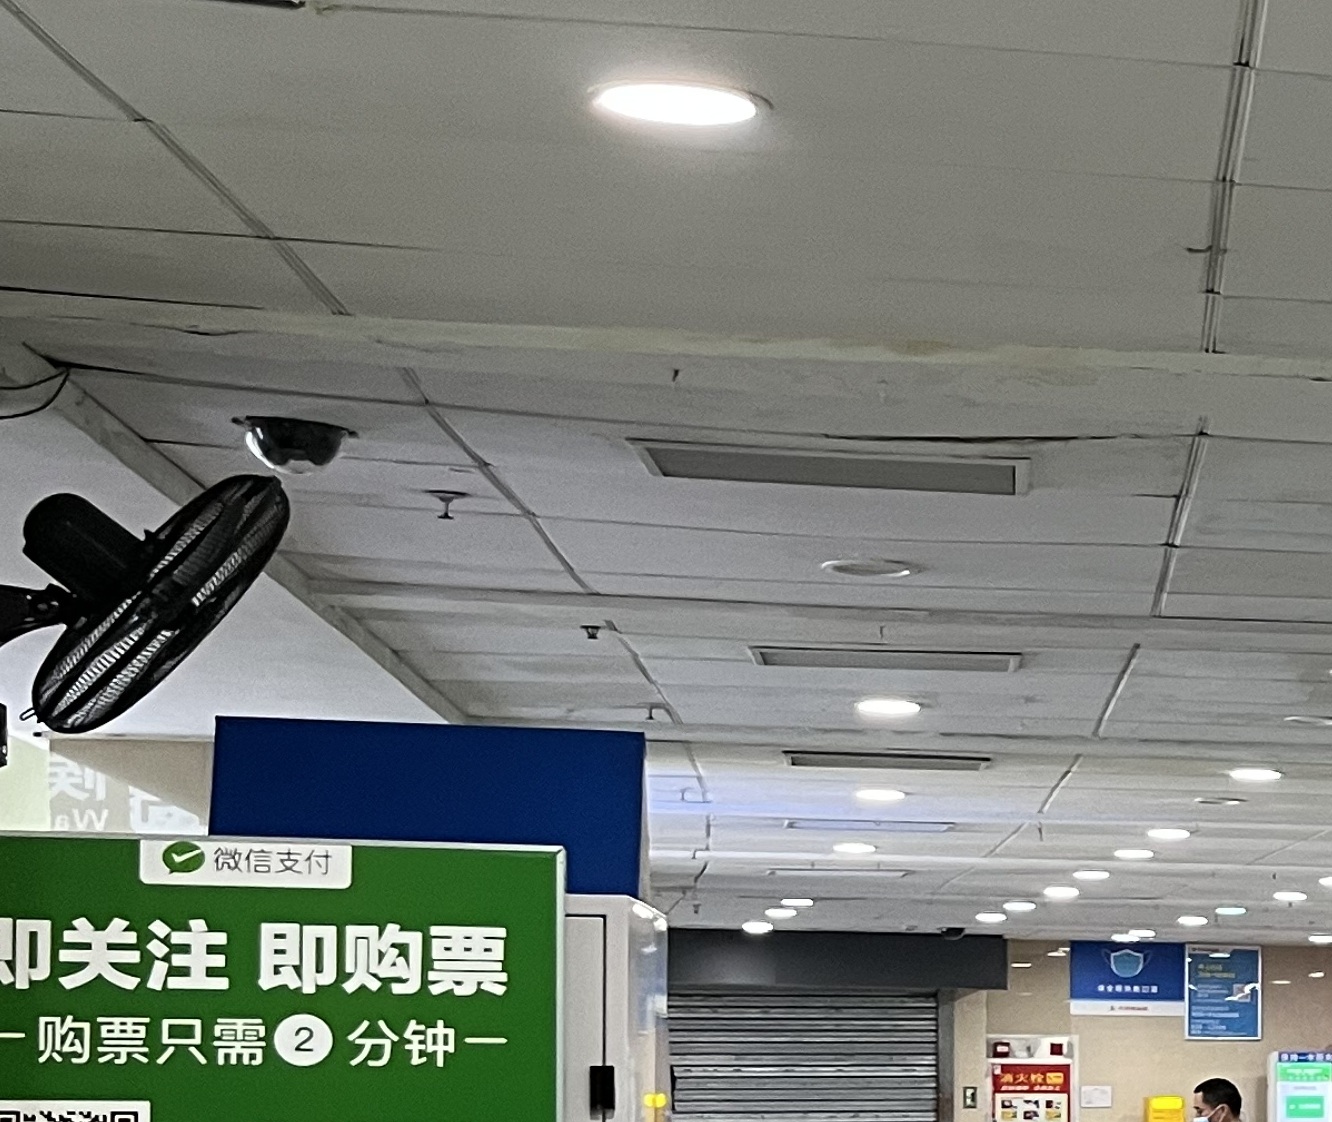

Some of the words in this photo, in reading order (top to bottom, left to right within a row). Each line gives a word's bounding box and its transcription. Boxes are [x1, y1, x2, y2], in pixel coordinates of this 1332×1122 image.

[213, 846, 333, 876] 微信支付
[0, 917, 229, 992] 即关注
[258, 923, 509, 997] 即购票
